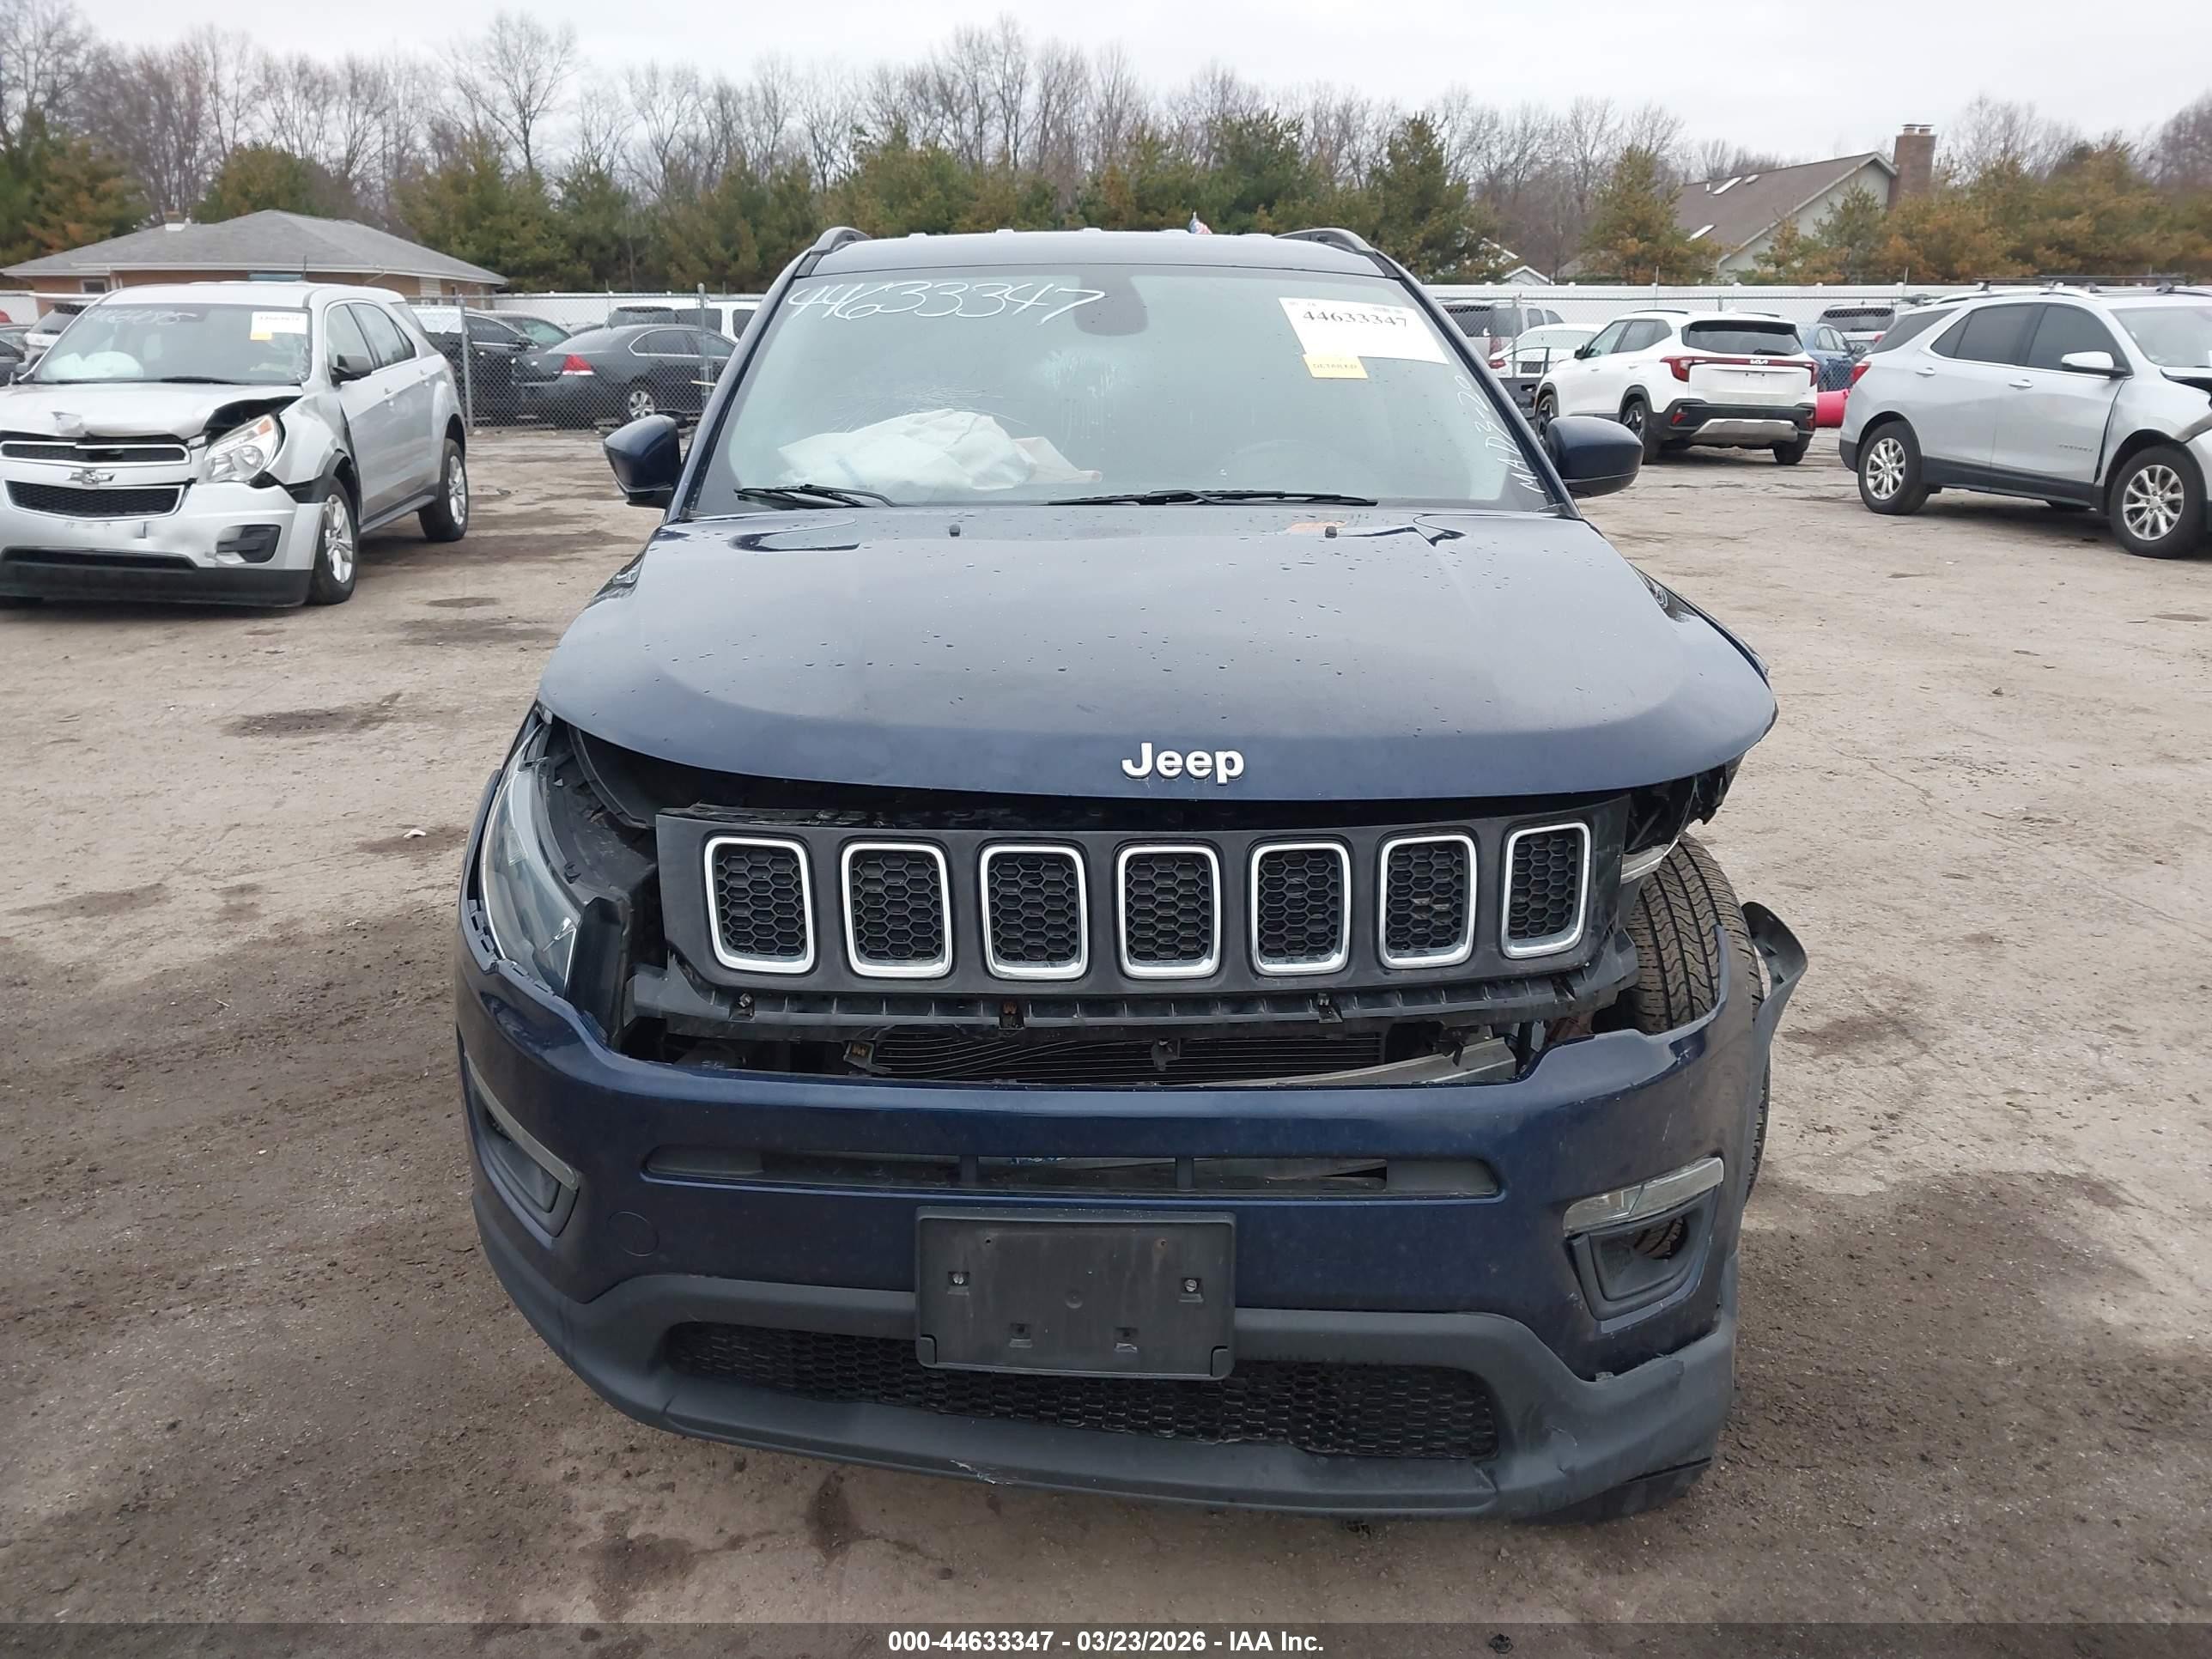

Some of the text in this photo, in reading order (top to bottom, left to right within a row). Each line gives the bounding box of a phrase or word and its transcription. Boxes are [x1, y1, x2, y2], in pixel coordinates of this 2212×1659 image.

[787, 281, 1106, 325] 44633347
[1303, 311, 1407, 327] 44633347
[1121, 742, 1245, 786] Jeep
